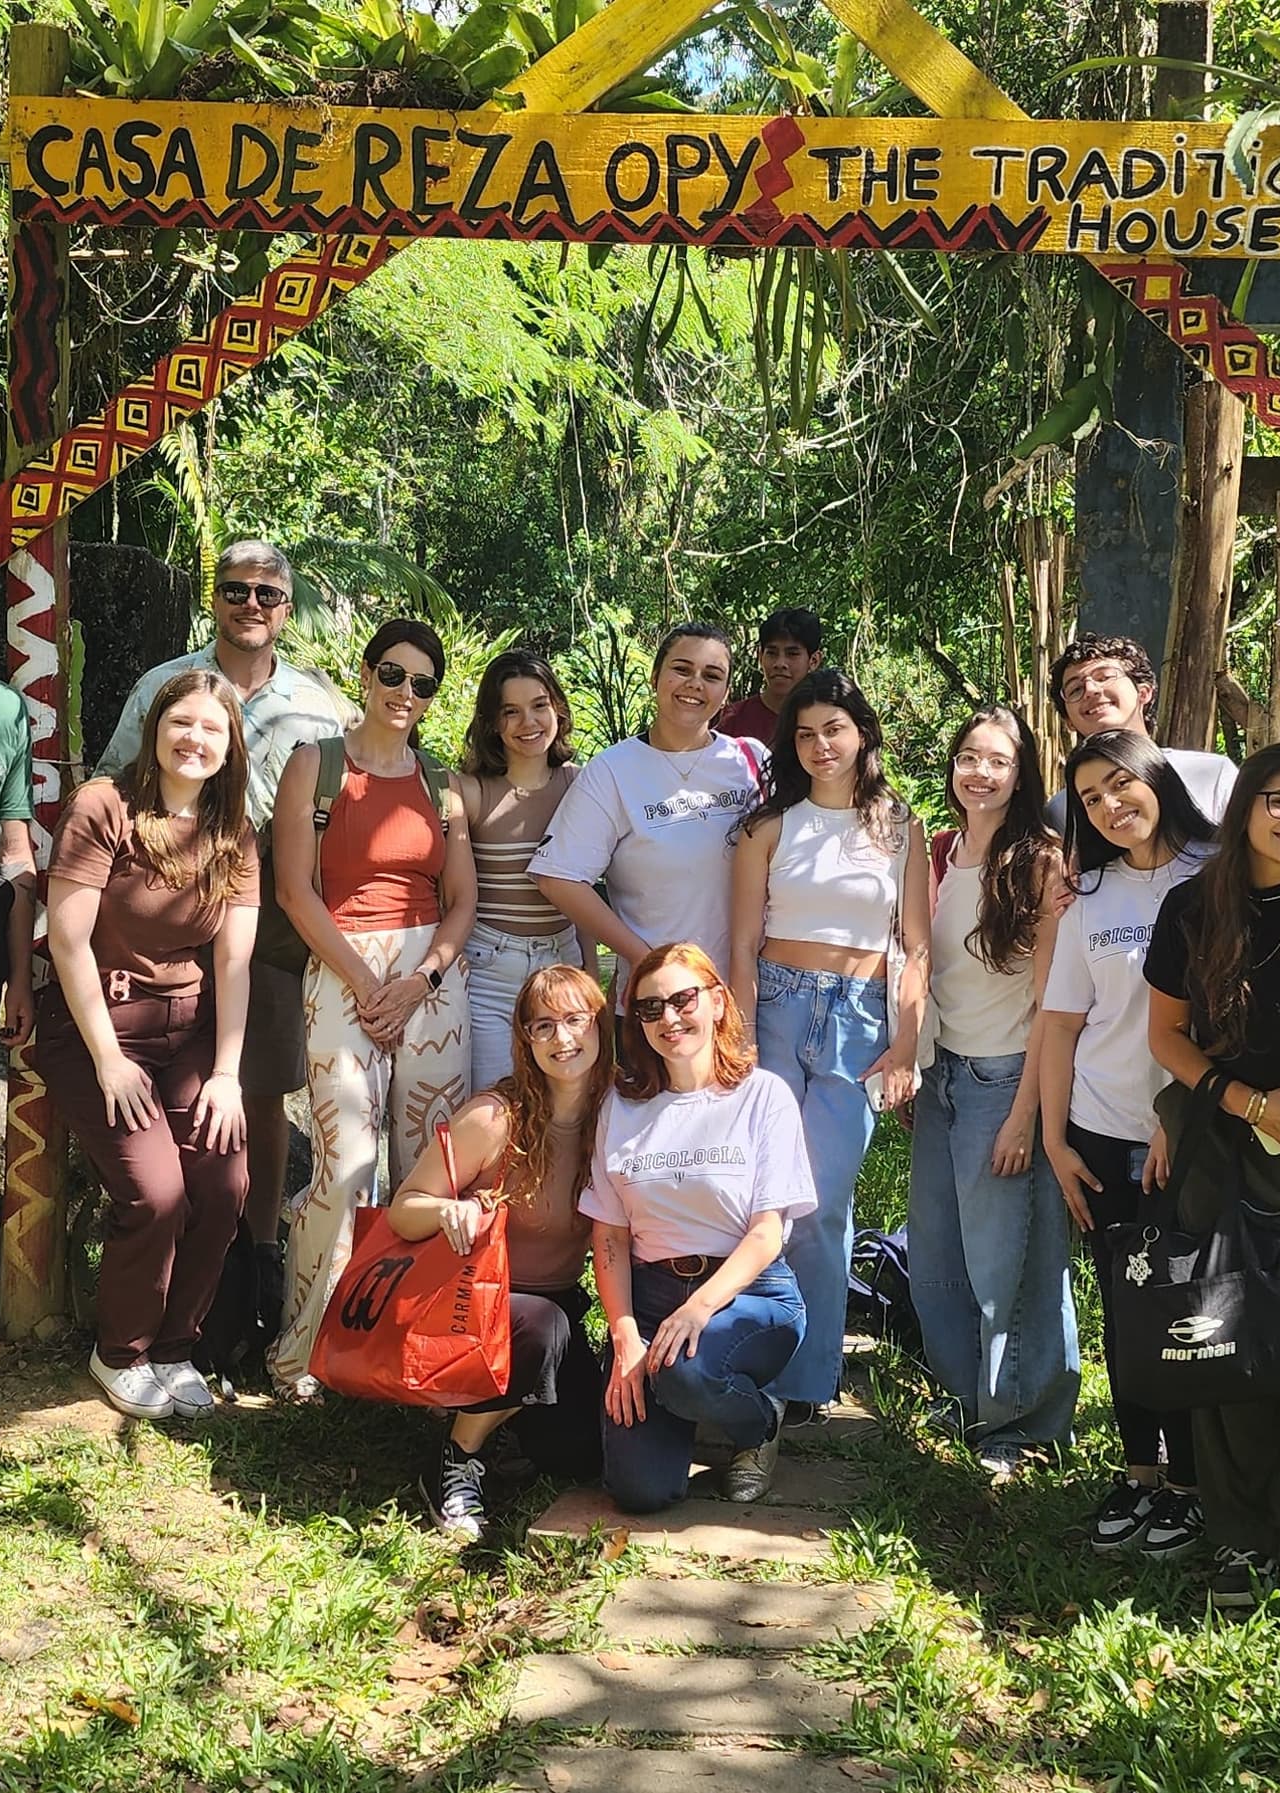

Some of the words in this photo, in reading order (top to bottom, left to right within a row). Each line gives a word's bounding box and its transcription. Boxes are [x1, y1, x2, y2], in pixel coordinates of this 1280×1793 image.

[25, 121, 205, 199] CASA
[225, 122, 323, 204] DE
[352, 125, 574, 223] REZA
[605, 132, 762, 222] OPY
[808, 146, 941, 205] THE
[620, 1146, 746, 1175] PSICOLOGIA
[451, 1264, 478, 1334] CARMIM
